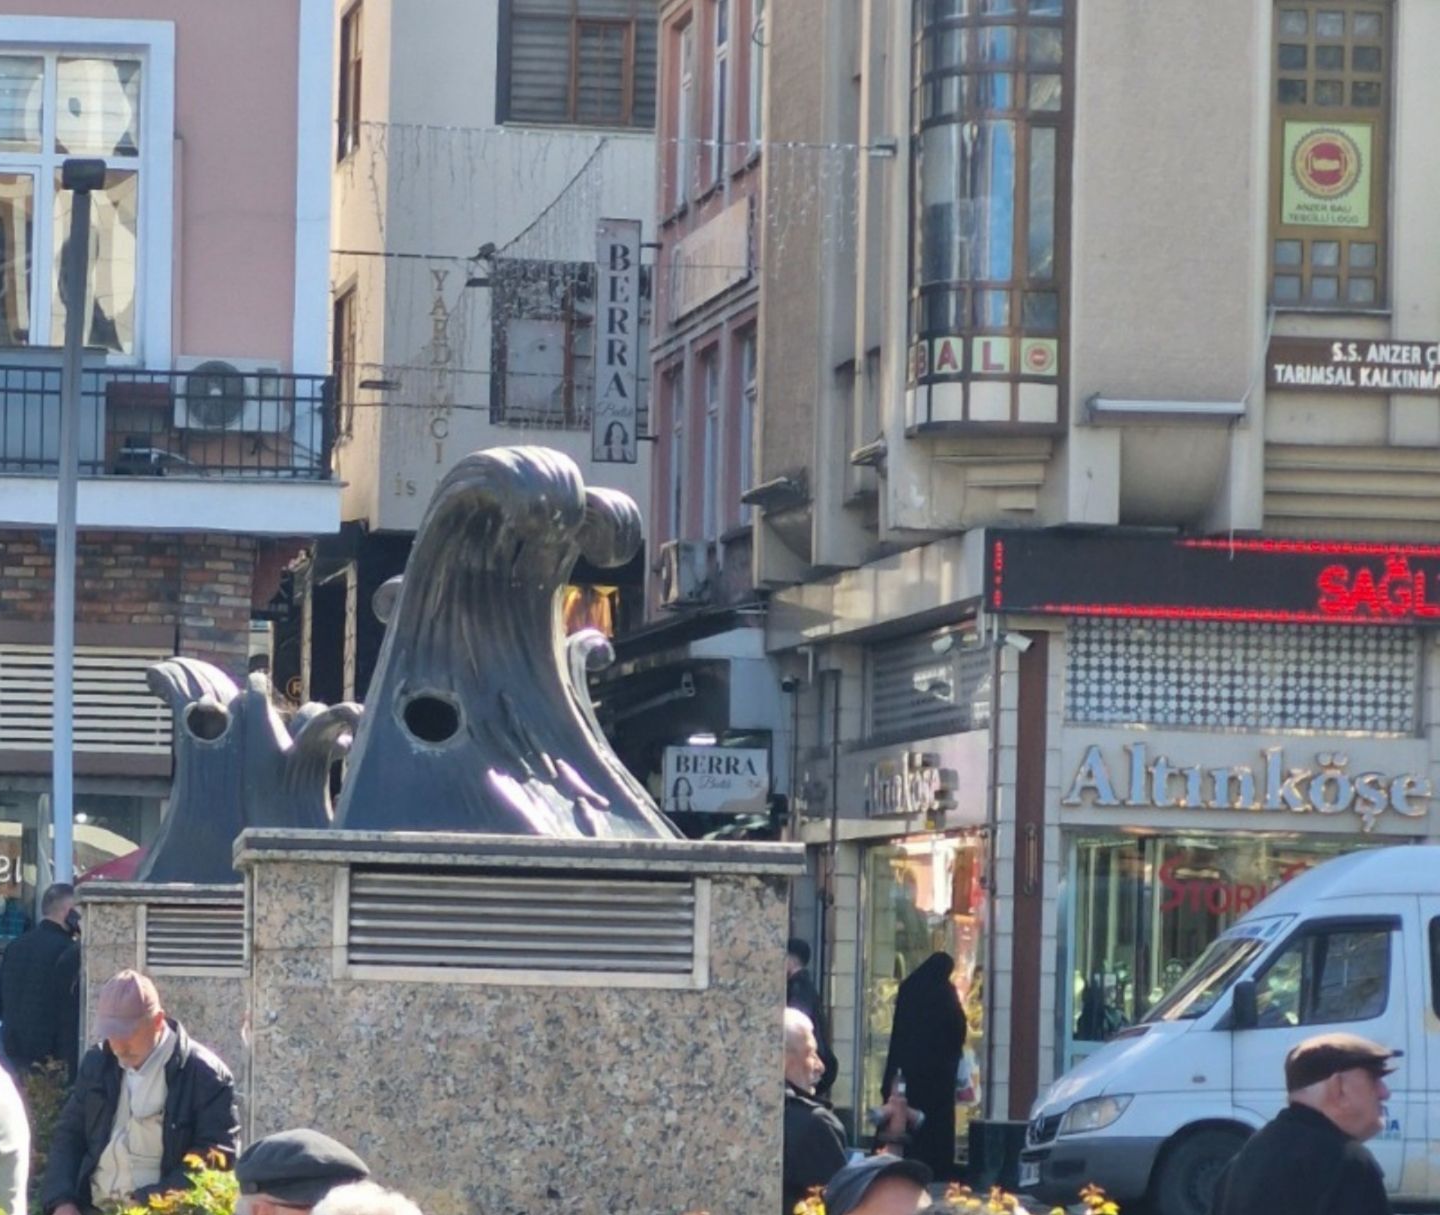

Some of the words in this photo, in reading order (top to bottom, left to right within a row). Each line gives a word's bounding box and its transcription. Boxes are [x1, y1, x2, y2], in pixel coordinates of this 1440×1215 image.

[604, 243, 632, 399] BERRA
[1274, 364, 1356, 386] TARIMSAL
[1332, 342, 1362, 362] S.S.
[1367, 343, 1422, 365] ANZER
[1318, 554, 1440, 617] SAĞL
[675, 755, 758, 776] BERRA
[1062, 741, 1432, 833] Altınköşe
